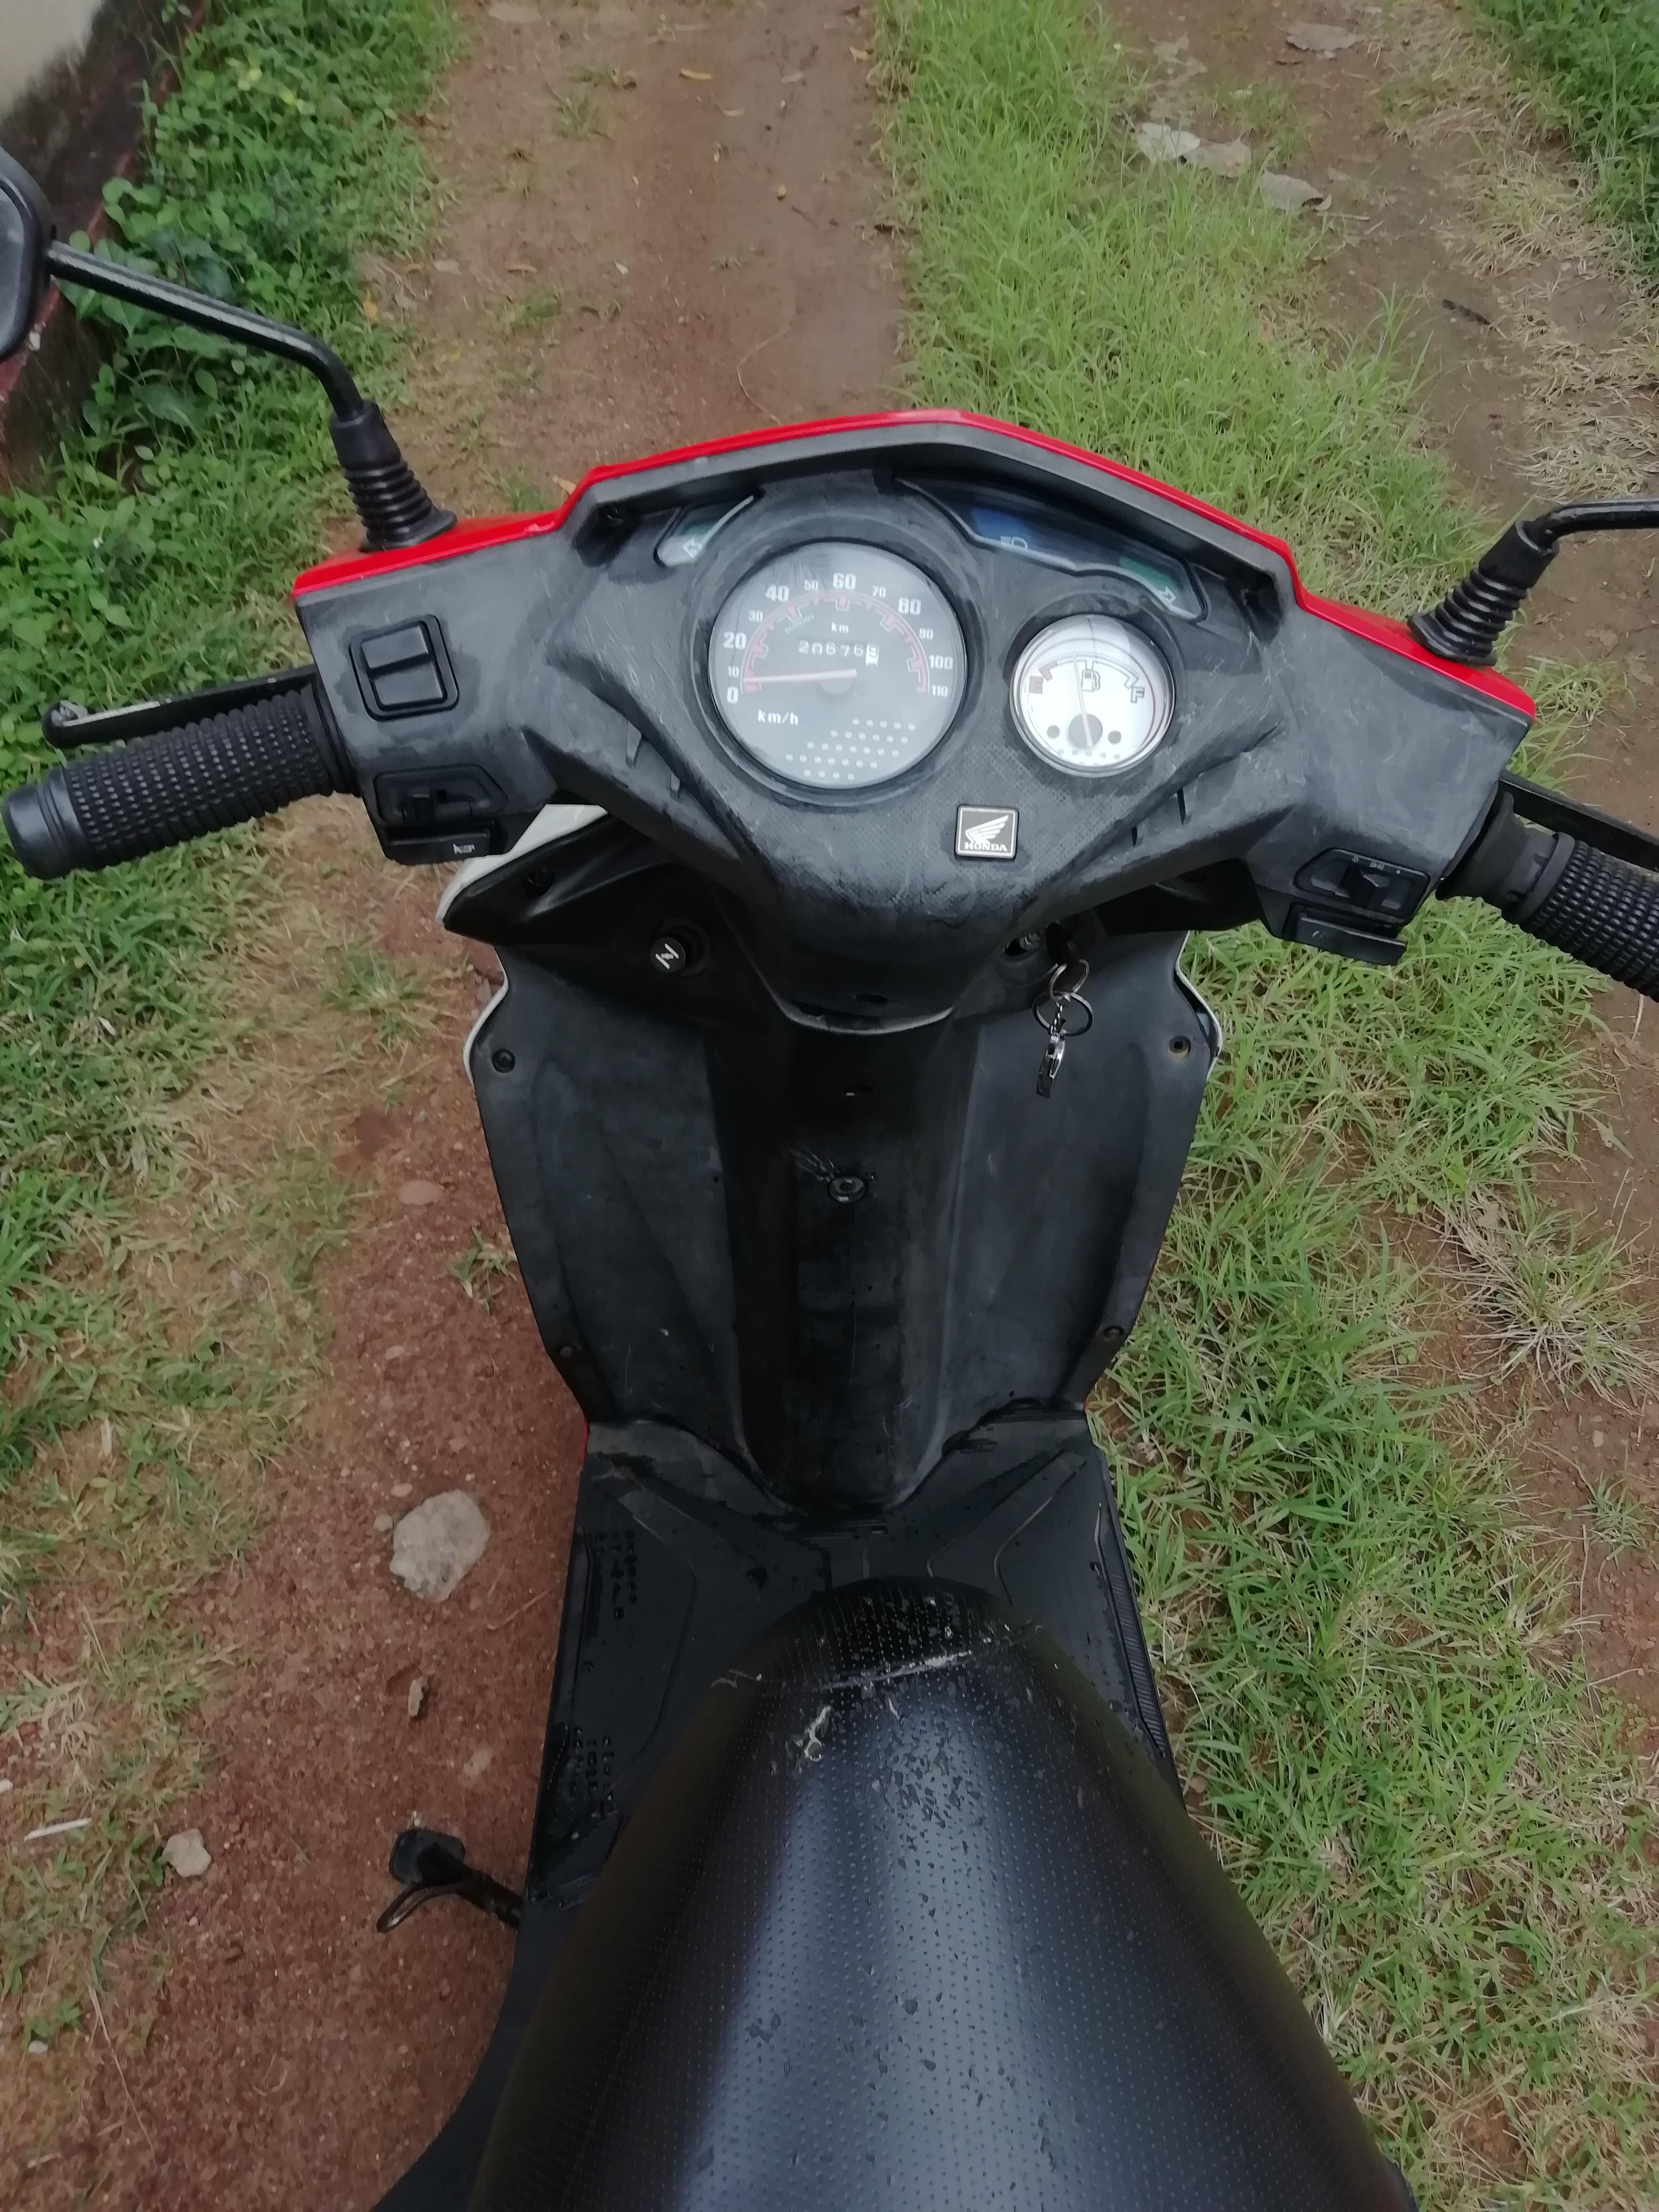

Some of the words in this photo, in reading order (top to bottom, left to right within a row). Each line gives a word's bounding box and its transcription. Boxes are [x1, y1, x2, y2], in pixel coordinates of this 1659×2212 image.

[804, 580, 819, 591] 50
[833, 573, 857, 590] 60
[765, 584, 789, 602] 40
[873, 585, 886, 598] 70
[898, 598, 921, 615] 80
[748, 610, 763, 622] 30
[831, 622, 849, 633] km
[723, 632, 747, 649] 20
[919, 629, 933, 640] 90
[929, 655, 953, 669] 100
[728, 666, 739, 677] 10
[726, 687, 739, 704] 0
[931, 685, 948, 697] 110
[1130, 686, 1145, 703] F
[758, 709, 799, 725] km/h
[964, 842, 1008, 851] HONDA
